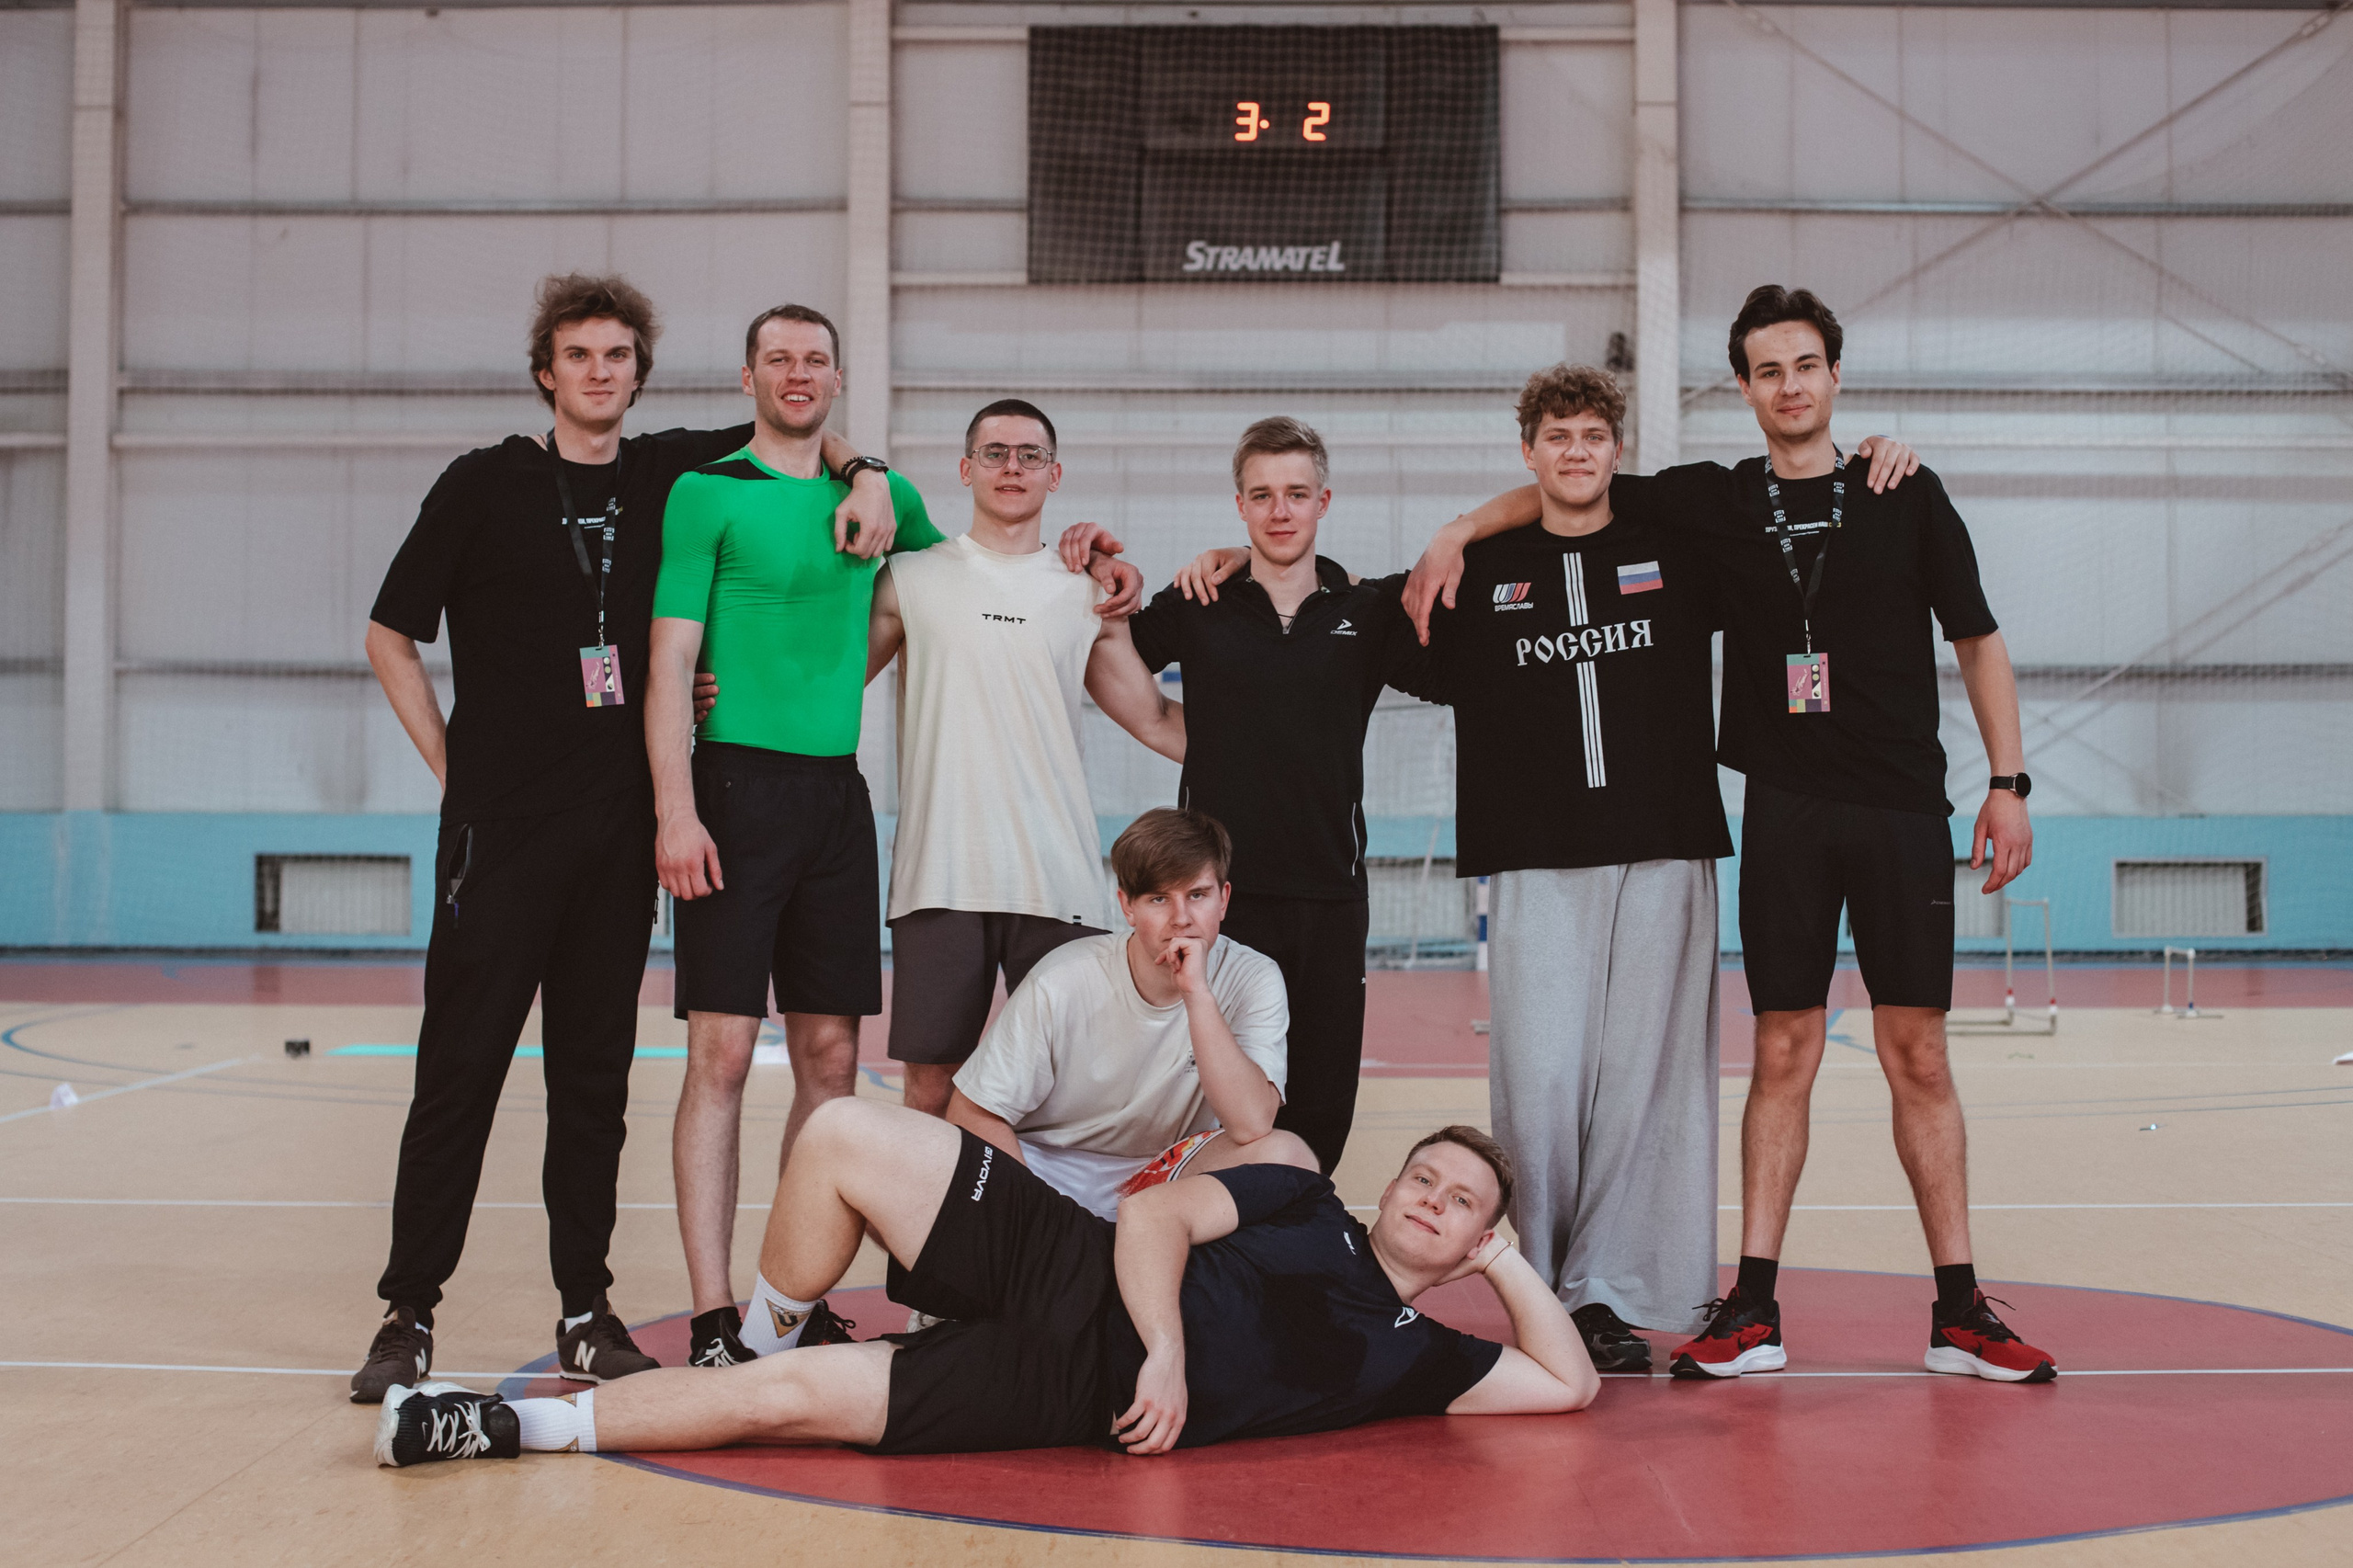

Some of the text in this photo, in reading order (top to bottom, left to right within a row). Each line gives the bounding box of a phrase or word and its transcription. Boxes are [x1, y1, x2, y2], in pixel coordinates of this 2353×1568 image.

[1302, 102, 1331, 142] 2
[982, 613, 1027, 625] TRMT
[1516, 619, 1654, 666] РОССИЯ
[971, 1145, 994, 1202] GIVOVA
